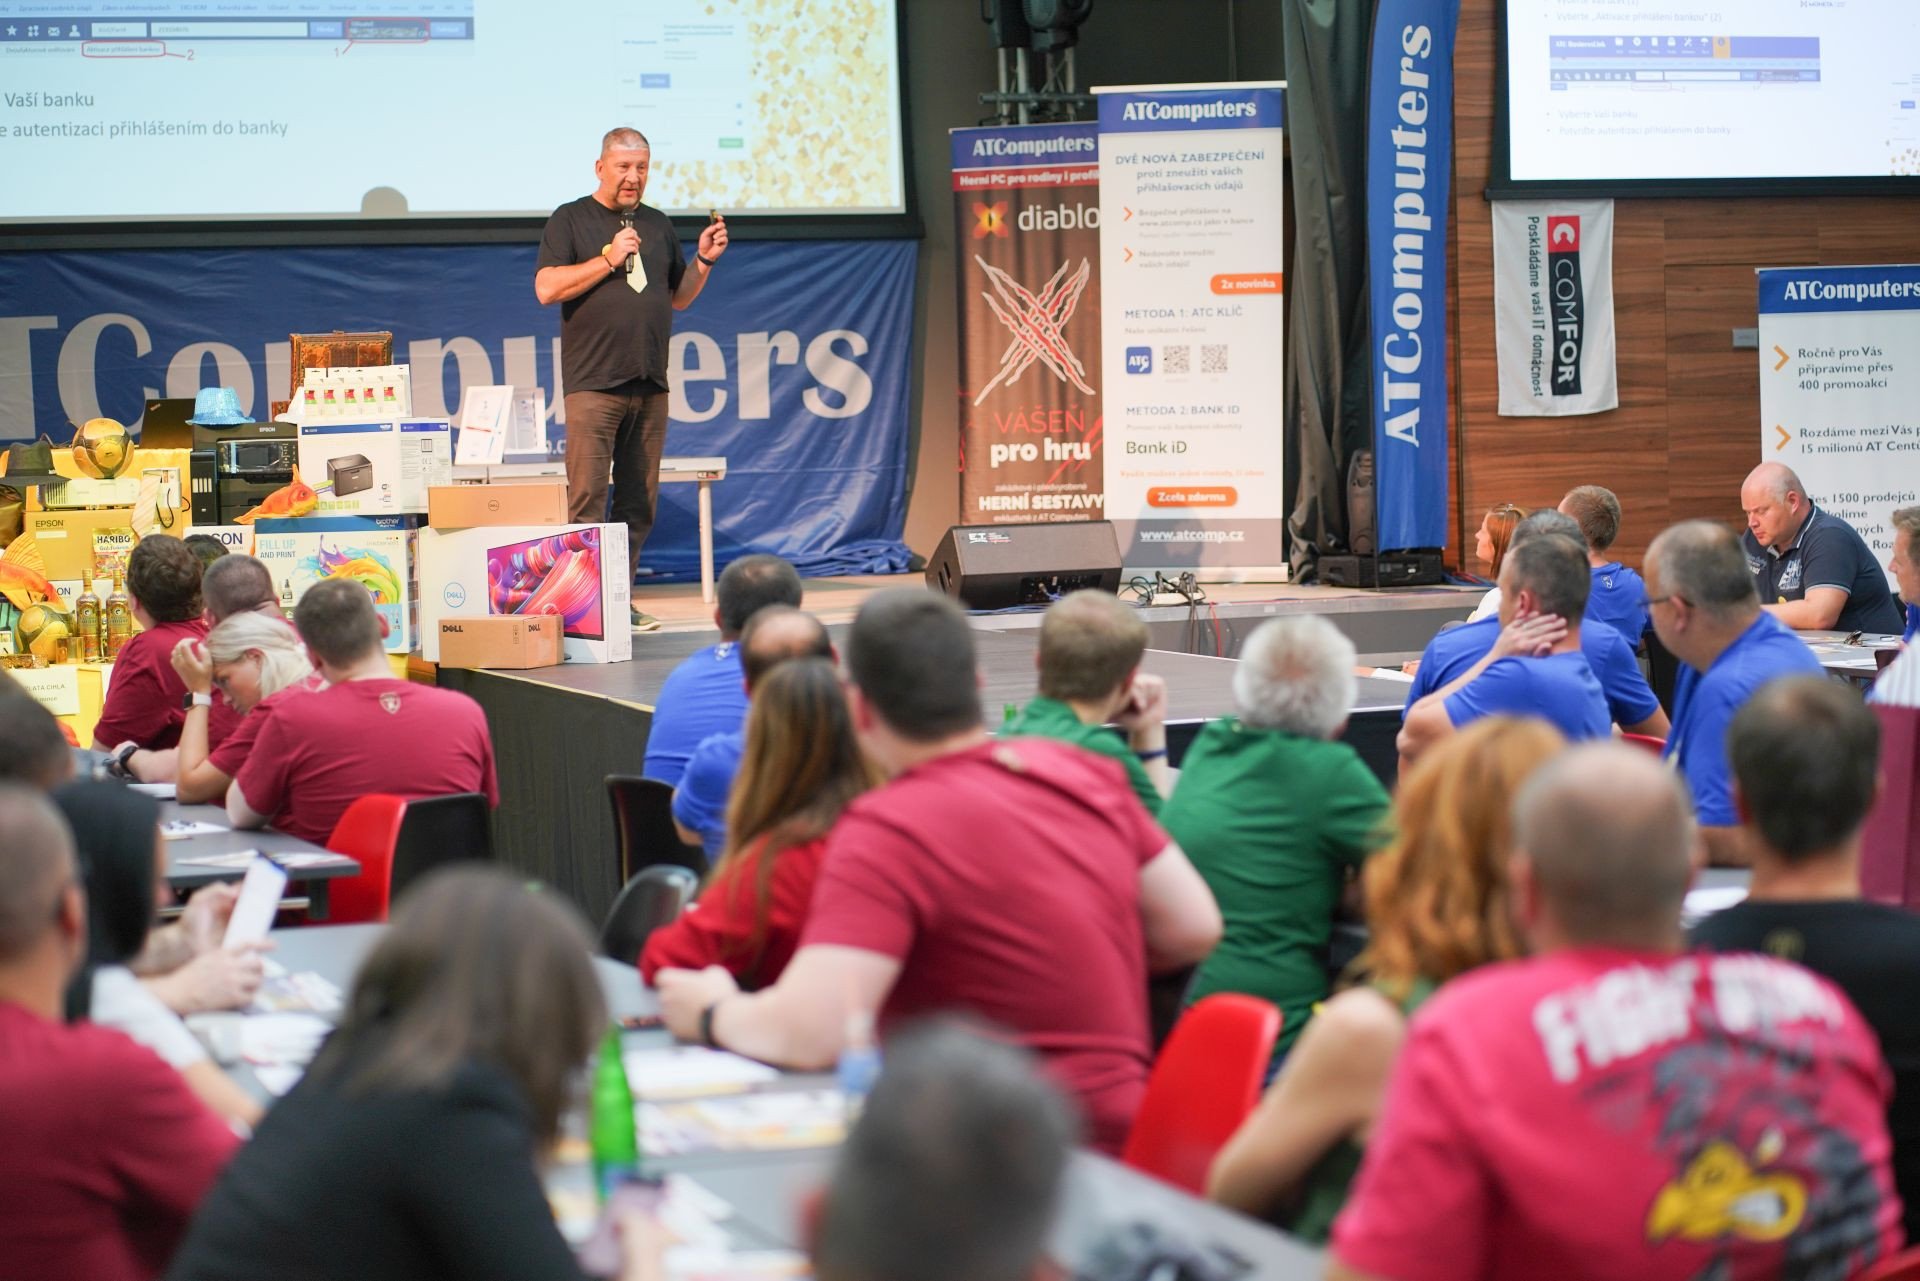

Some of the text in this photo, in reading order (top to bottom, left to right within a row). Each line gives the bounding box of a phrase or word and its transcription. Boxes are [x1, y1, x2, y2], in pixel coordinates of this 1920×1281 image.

[187, 49, 195, 60] 2
[5, 91, 95, 107] Vaší banku
[1123, 100, 1256, 123] ATComputers
[13, 121, 104, 137] autentizaci
[109, 120, 207, 139] přihlášením
[212, 120, 233, 136] do
[239, 119, 289, 139] banky
[973, 136, 1095, 157] ATComputers
[1181, 148, 1265, 163] ZABEZPEČENÍ
[991, 174, 1006, 185] PC
[1007, 174, 1026, 186] pro
[1027, 171, 1062, 184] rodiny
[1137, 169, 1162, 180] proti
[1211, 165, 1243, 176] vašich
[1018, 203, 1100, 231] diablo
[1384, 24, 1432, 447] ATComputers
[1528, 216, 1540, 288] Poskládáme
[1221, 277, 1275, 290] 2x novinka
[1784, 279, 1920, 303] ATComputers
[1125, 308, 1175, 319] METODA
[1191, 307, 1214, 318] ATC
[1532, 320, 1545, 330] IT
[1555, 258, 1578, 384] COMFOR
[1798, 346, 1882, 360] Ročně pro Vás
[1531, 335, 1544, 397] domácnost
[1798, 361, 1893, 377] připravíme přes
[1798, 378, 1888, 392] 400 promoakcí
[1126, 406, 1176, 416] METODA
[1191, 405, 1224, 415] BANK
[1228, 404, 1240, 415] ID
[993, 403, 1085, 434] VÁŠEŇ
[1800, 426, 1856, 439] Rozdáme
[1860, 425, 1889, 436] mezi
[1891, 424, 1913, 435] Vás
[990, 437, 1091, 468] pro hru
[1126, 441, 1187, 454] Bank iD
[1801, 443, 1813, 454] 15
[1818, 442, 1863, 453] milionů
[1866, 441, 1882, 452] AT
[979, 492, 1104, 511] HERNÍ SESTAVY
[1157, 490, 1226, 502] Zcela zdarma
[1833, 492, 1859, 504] 1500
[1863, 491, 1915, 505] prodejců
[35, 519, 64, 528] EPSON
[97, 534, 131, 544] HARIBO
[1140, 529, 1245, 543] www.atcomp.cz
[259, 538, 296, 551] FILL UP
[260, 550, 296, 559] AND PRINT
[447, 590, 463, 600] DELL
[442, 625, 463, 633] DELL
[528, 624, 541, 633] DELL
